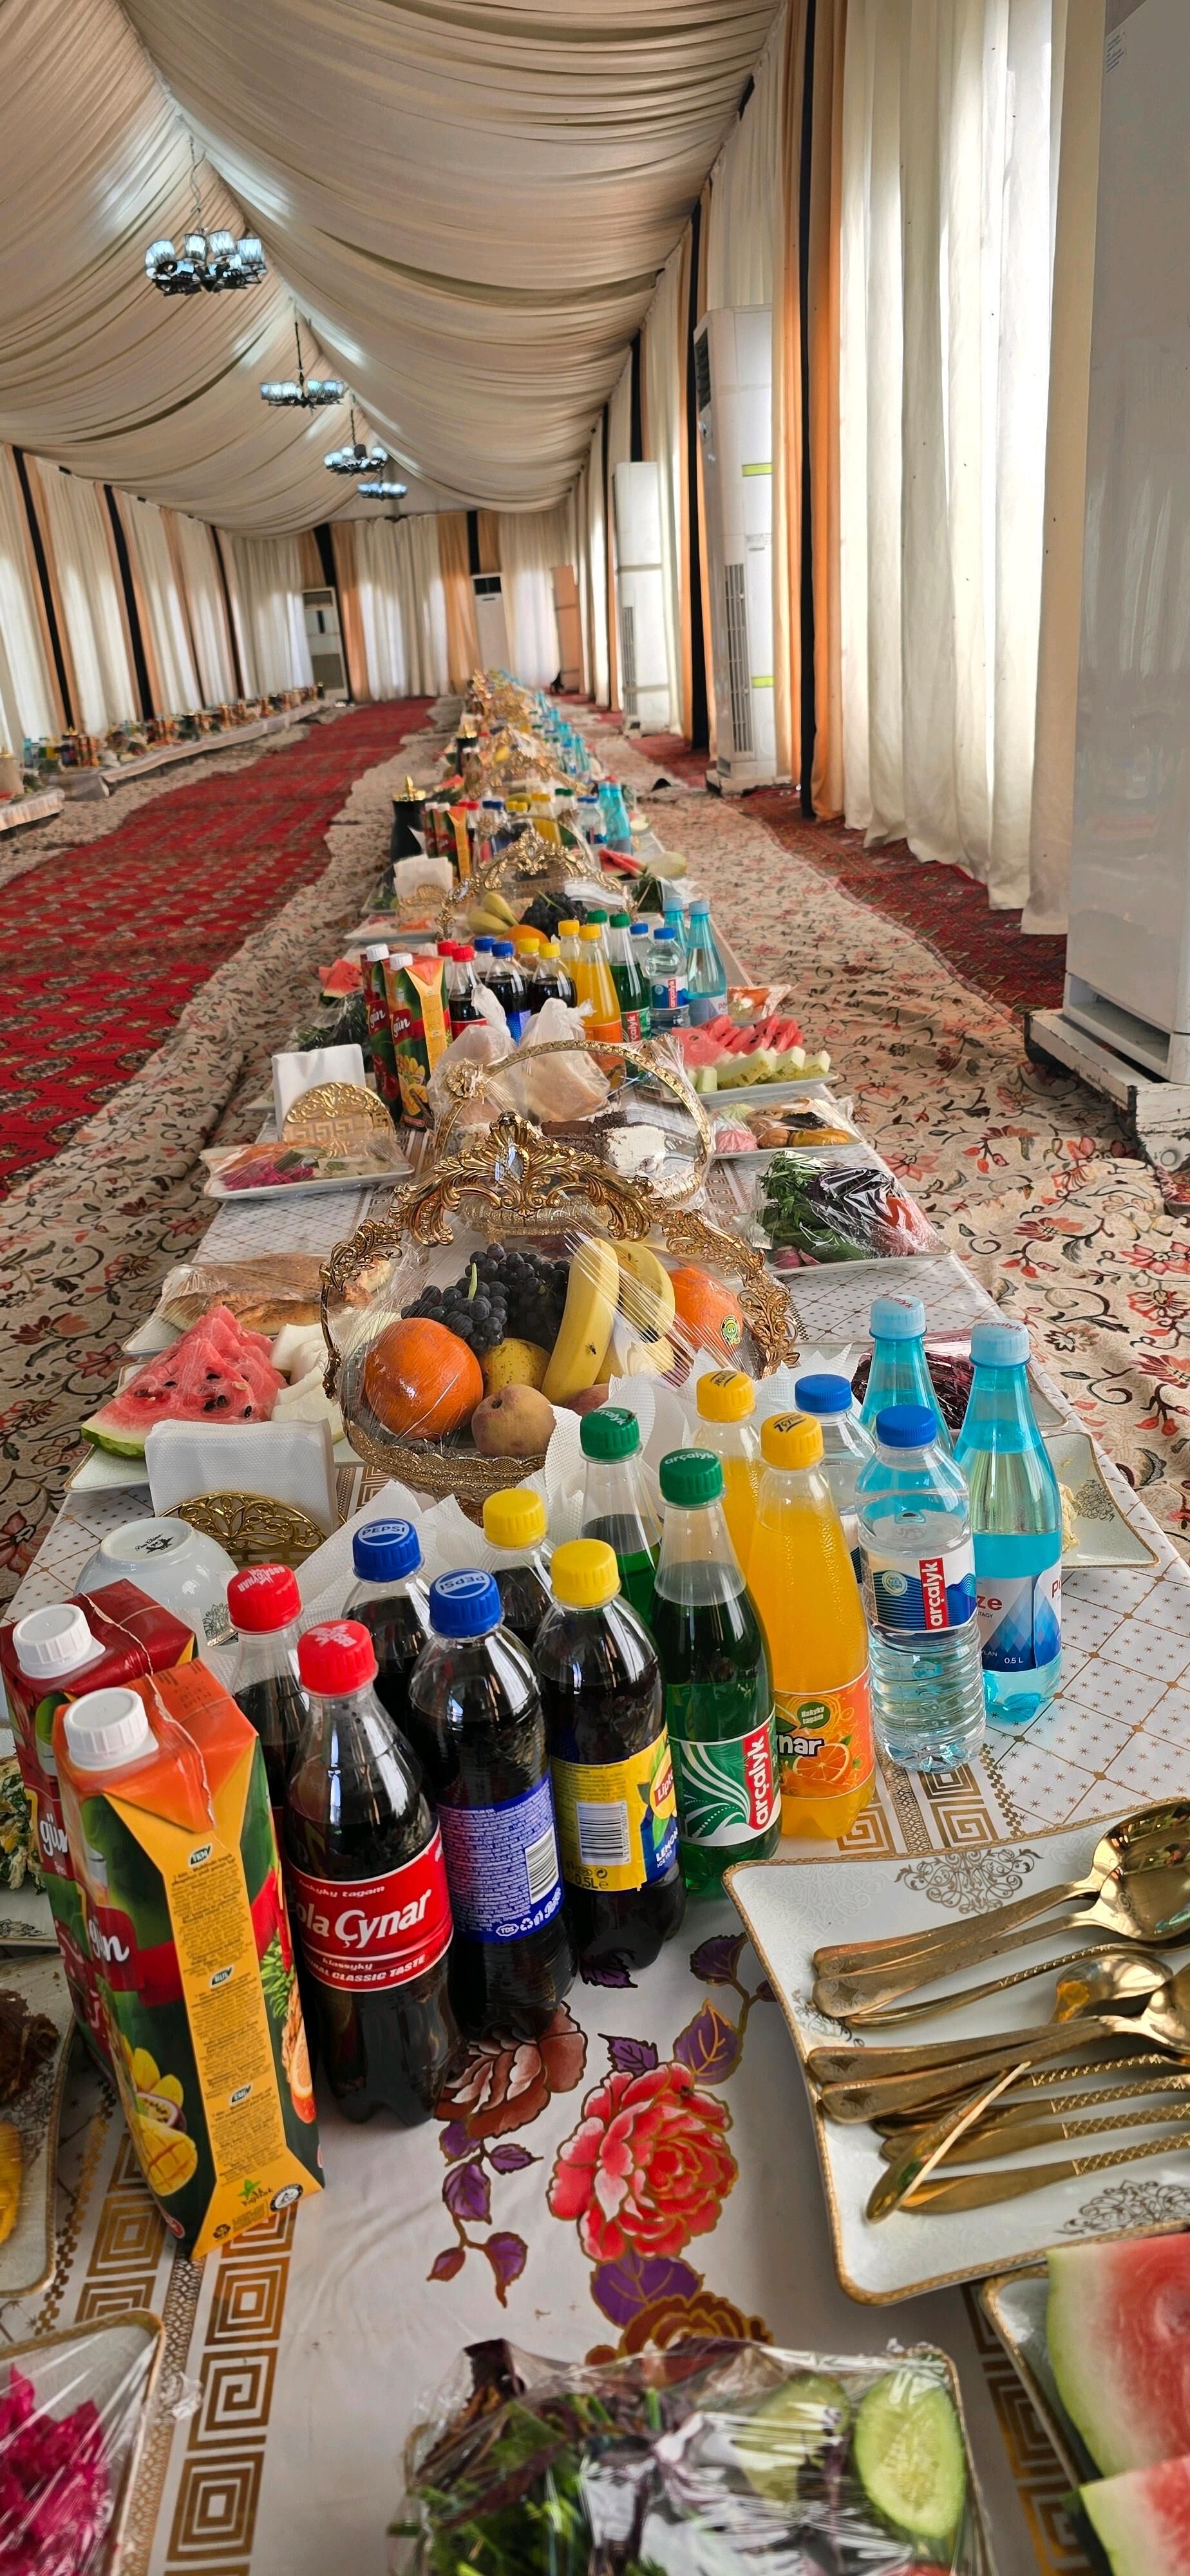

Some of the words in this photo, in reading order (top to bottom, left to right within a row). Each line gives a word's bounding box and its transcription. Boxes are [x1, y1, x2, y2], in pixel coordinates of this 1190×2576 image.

[664, 1452, 715, 1465] arçalyk
[363, 1526, 405, 1535] PEPSI
[440, 1576, 485, 1590] PEPSI
[921, 1561, 944, 1626] arçalyk
[748, 1736, 769, 1825] arçalyk
[335, 1889, 431, 1949] Çynar
[332, 1972, 386, 1982] CLASSIC
[390, 1954, 426, 1977] TASTE
